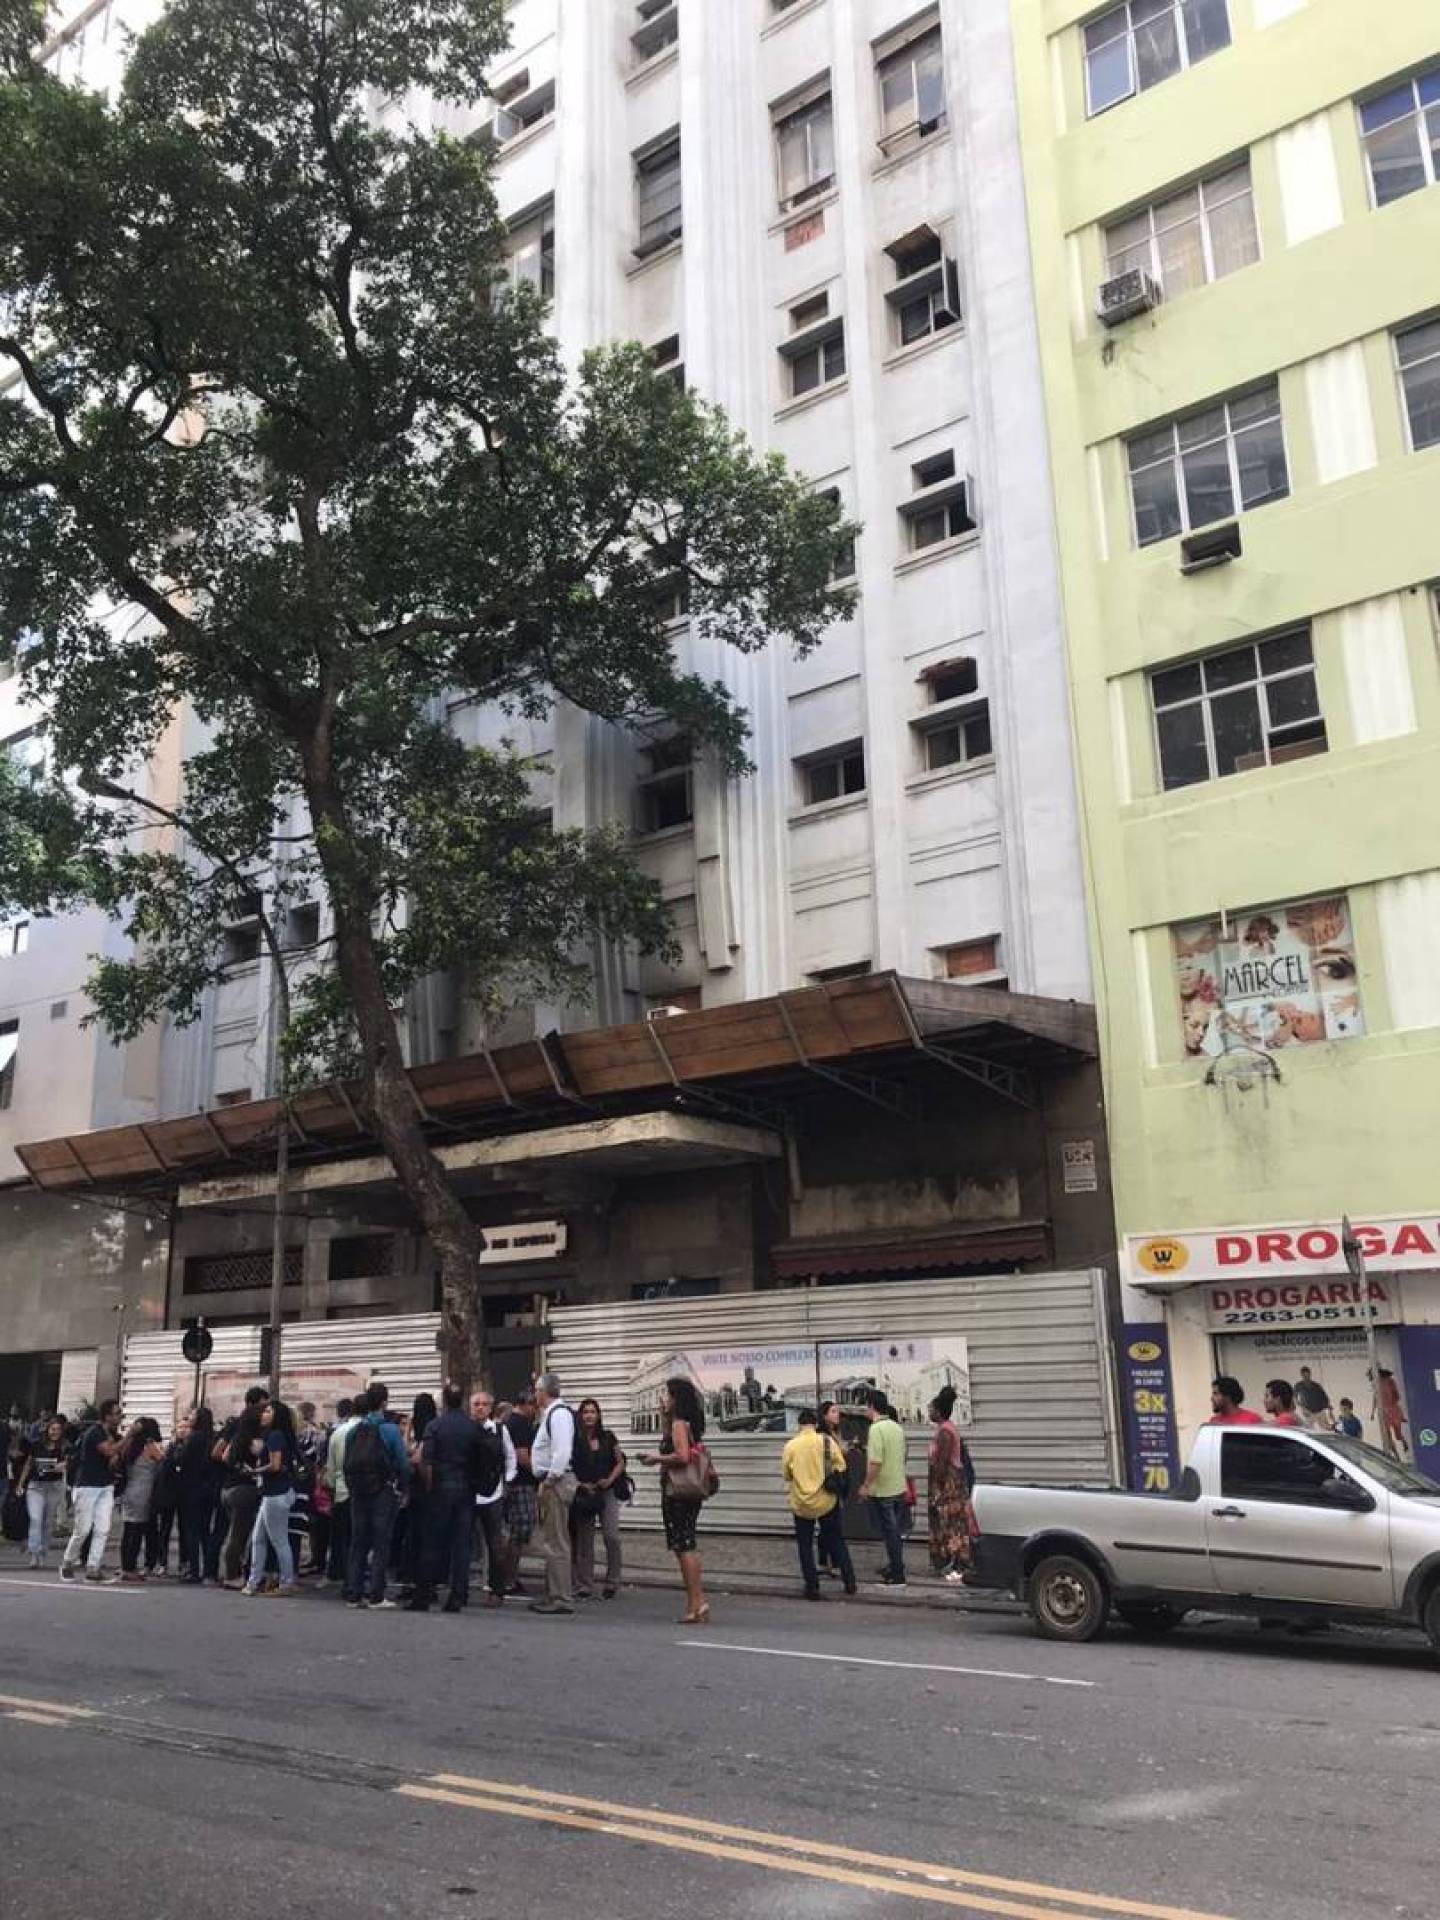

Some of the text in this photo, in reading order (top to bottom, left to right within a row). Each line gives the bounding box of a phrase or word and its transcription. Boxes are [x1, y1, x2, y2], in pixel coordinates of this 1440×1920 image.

[1224, 954, 1309, 996] MARCEL
[1216, 1223, 1440, 1265] DROGA
[1211, 1281, 1388, 1310] DROGARIA
